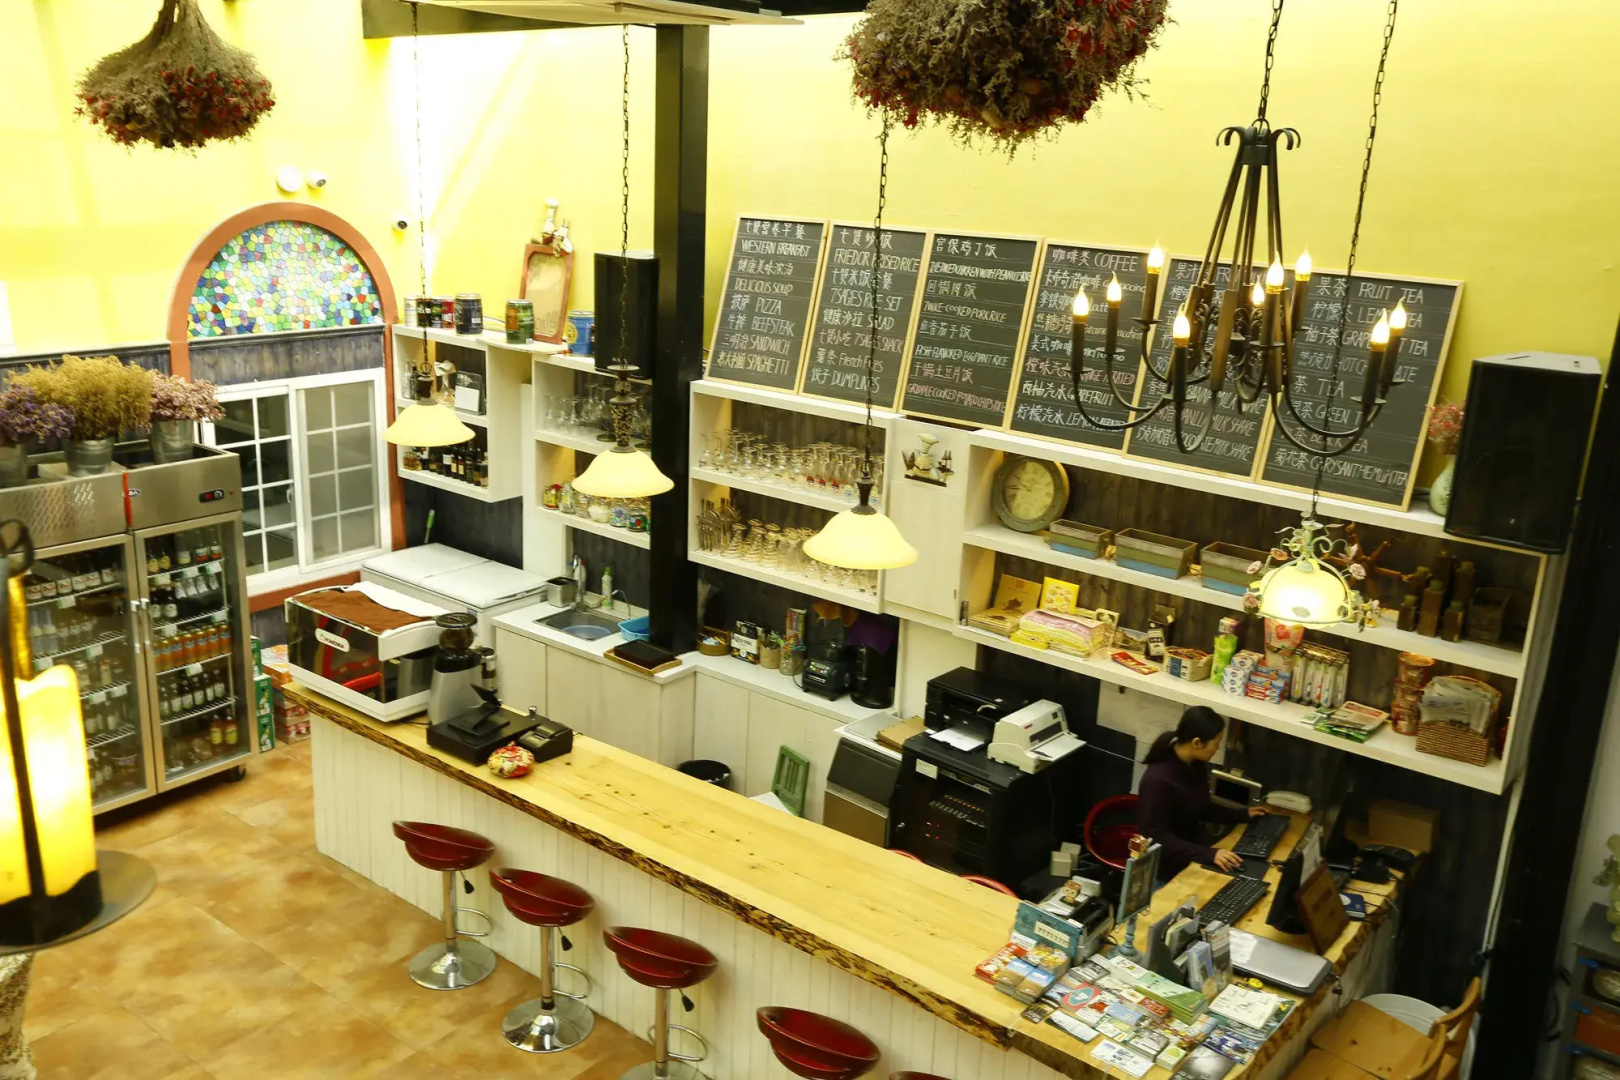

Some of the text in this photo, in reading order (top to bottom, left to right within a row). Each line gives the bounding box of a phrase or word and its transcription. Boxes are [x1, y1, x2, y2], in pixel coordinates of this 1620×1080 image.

[741, 240, 777, 254] WESTERN
[1094, 252, 1139, 272] COFFEE
[733, 278, 794, 296] DELICIOUS SOUP
[1358, 282, 1393, 300] FRUIT
[1400, 288, 1424, 304] TEA
[755, 297, 782, 315] PIZZA
[885, 295, 903, 313] SET
[751, 316, 796, 337] BEEFSTEAK
[748, 334, 791, 355] SANDWICH
[1408, 339, 1428, 357] TEA
[746, 354, 791, 375] SPAGHETTI
[1295, 375, 1308, 393] 茶
